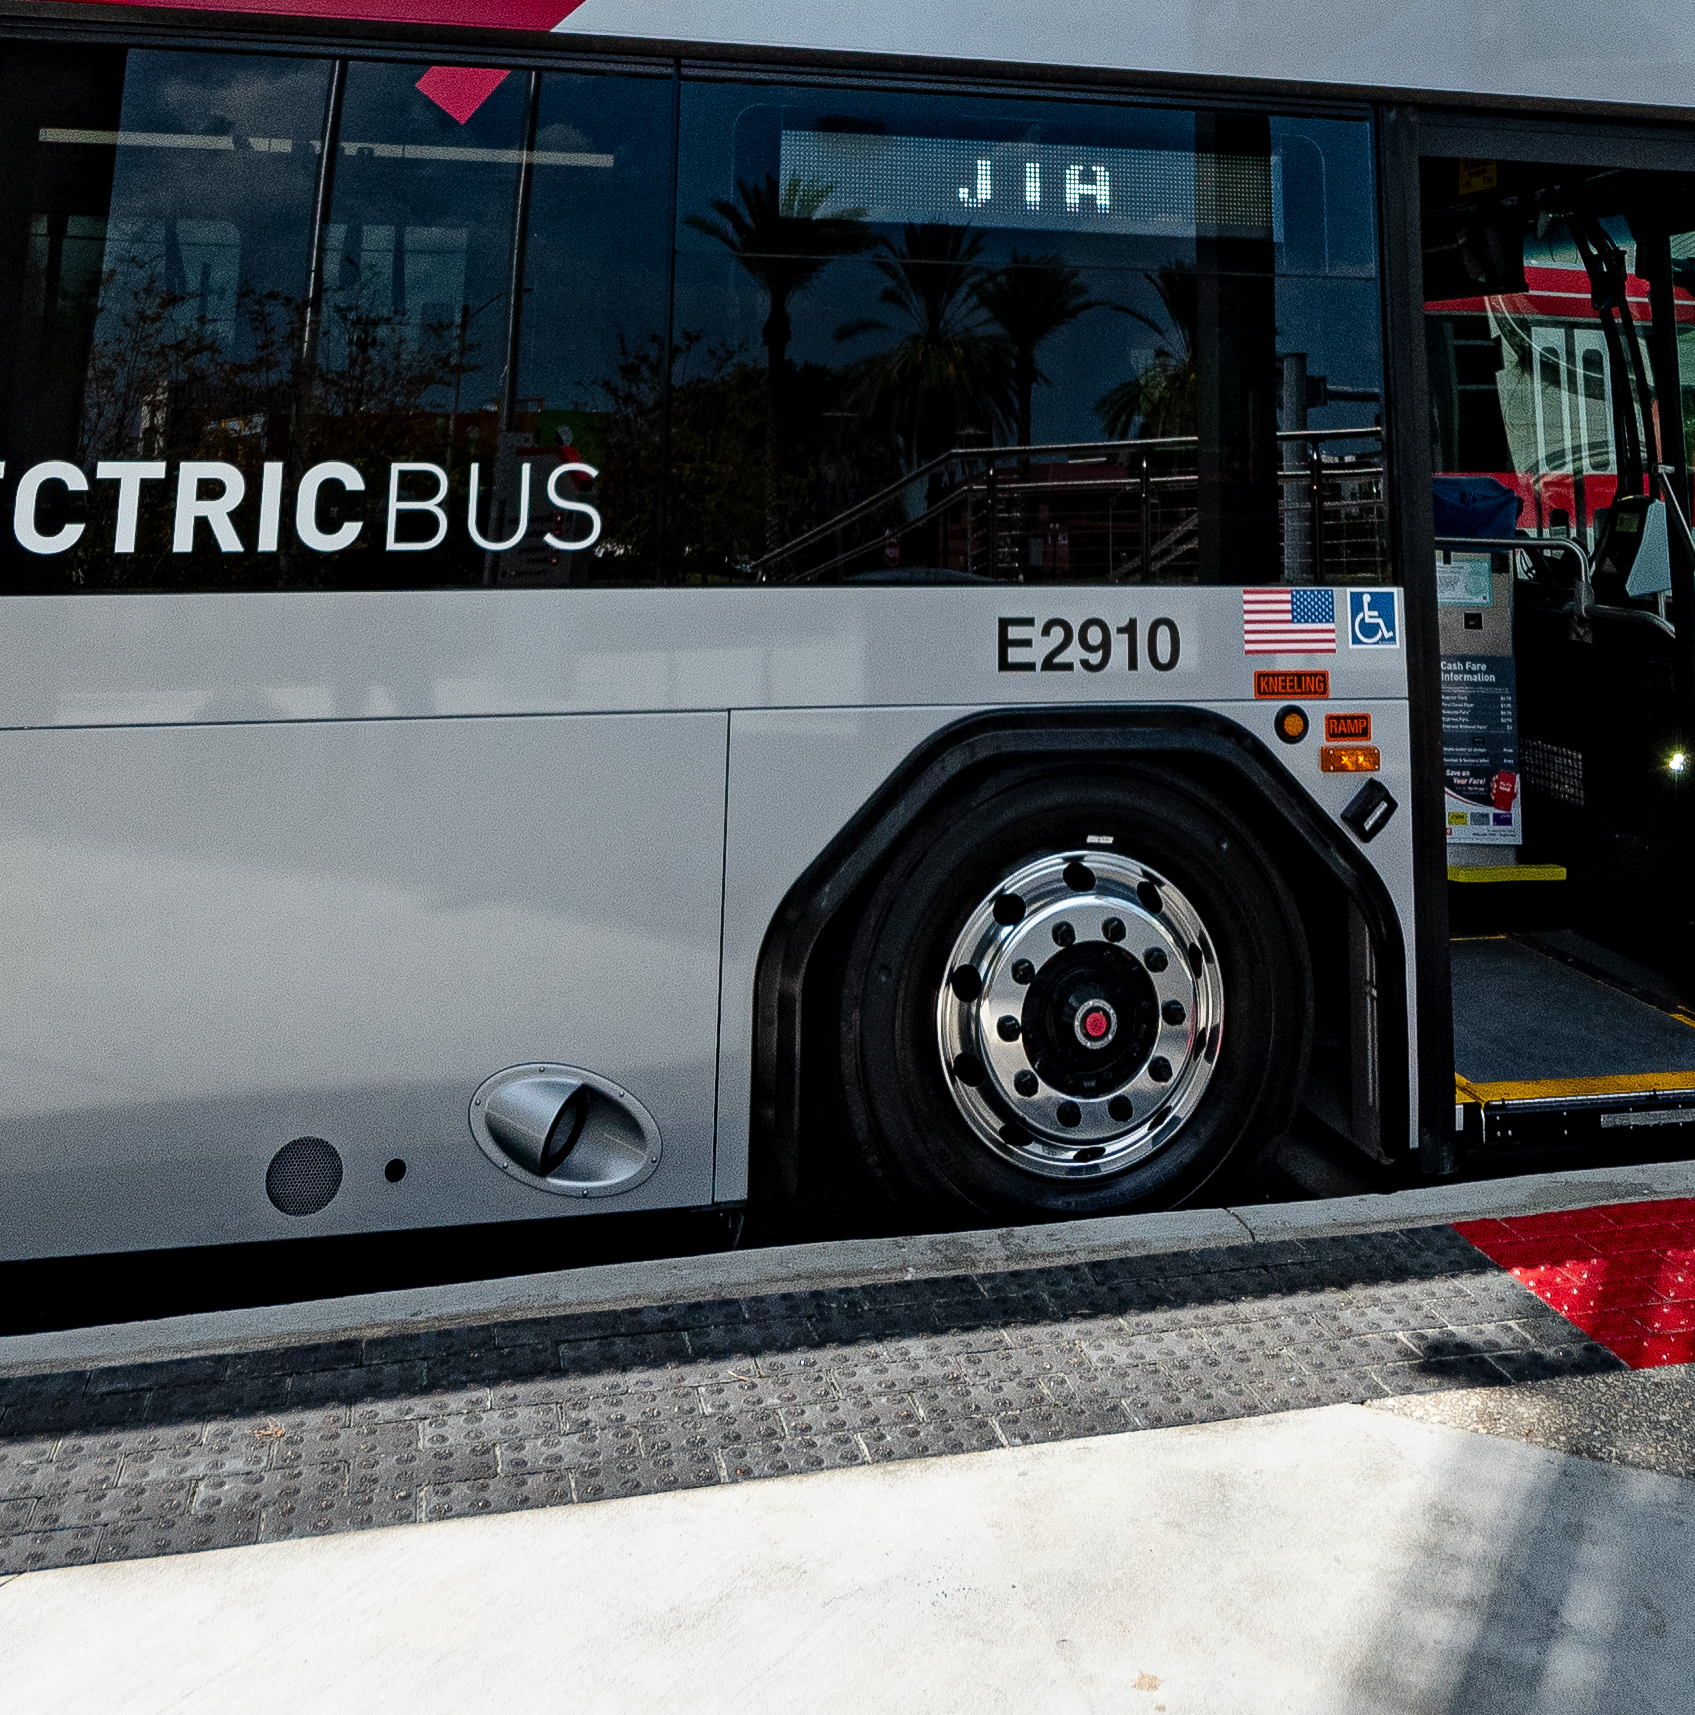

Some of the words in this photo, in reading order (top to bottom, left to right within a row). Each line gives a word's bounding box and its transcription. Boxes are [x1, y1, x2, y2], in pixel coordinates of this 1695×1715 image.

[385, 461, 603, 552] BUS
[996, 616, 1182, 674] E2910
[1441, 661, 1463, 671] Cash
[1466, 662, 1487, 671] Fare
[1259, 675, 1325, 694] KNEELING
[1441, 671, 1496, 682] Information
[1329, 718, 1368, 735] RAMP
[1453, 777, 1467, 785] Your
